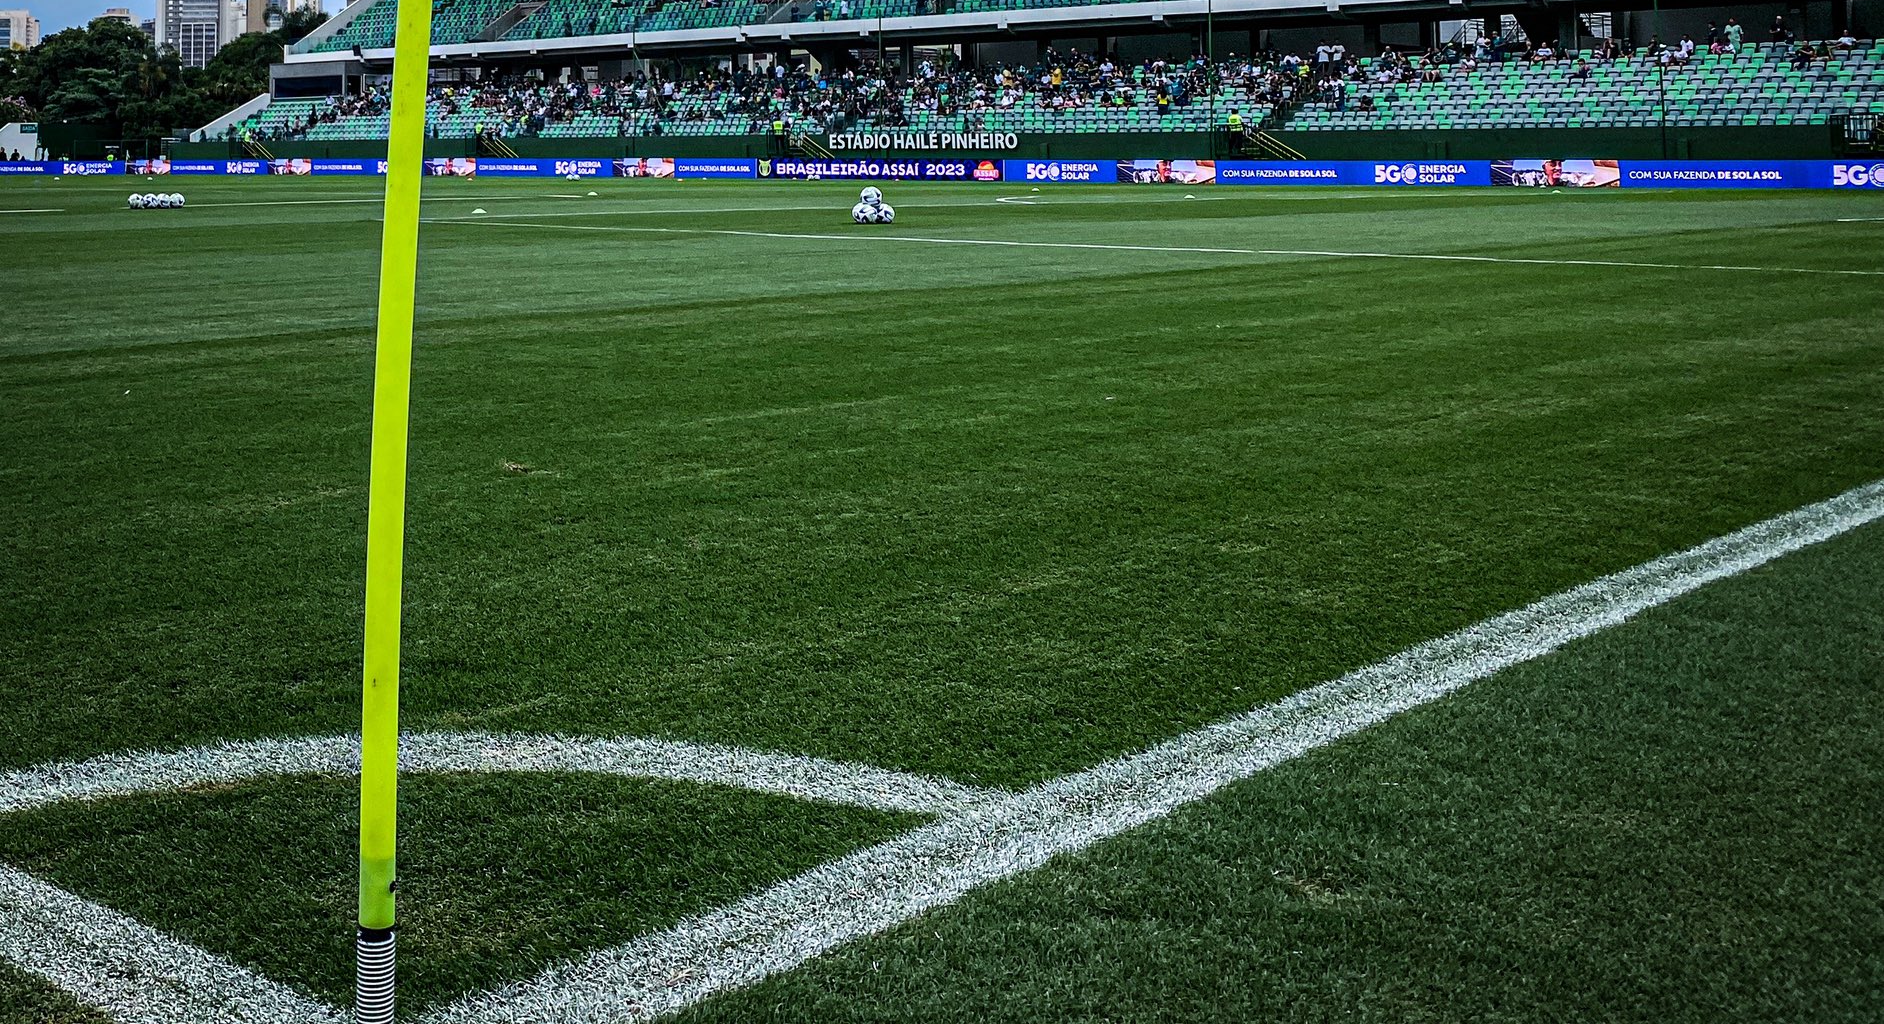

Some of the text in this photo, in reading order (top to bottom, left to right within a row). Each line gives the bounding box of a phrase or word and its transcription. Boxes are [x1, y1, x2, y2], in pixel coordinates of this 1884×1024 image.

[829, 130, 1018, 150] ESTÁDIO HAILÉ PINHEIRO
[776, 160, 966, 176] BRASILEIRÃO ASSAÍ 2023
[1026, 163, 1048, 180] 5G
[1061, 163, 1099, 172] ENERGIA
[1419, 164, 1467, 174] ENERGIA
[1061, 172, 1090, 180] SOLAR
[1222, 169, 1240, 178] COM
[1240, 169, 1255, 178] SUA
[1256, 169, 1288, 178] FAZENDA
[1288, 169, 1300, 178] DE
[1374, 164, 1401, 183] 5G
[1419, 174, 1455, 183] SOLAR
[1629, 170, 1652, 180] COM
[1653, 170, 1672, 180] SUA
[1673, 170, 1716, 180] FAZENDA
[1717, 170, 1731, 180] DE
[1833, 164, 1869, 186] 5G
